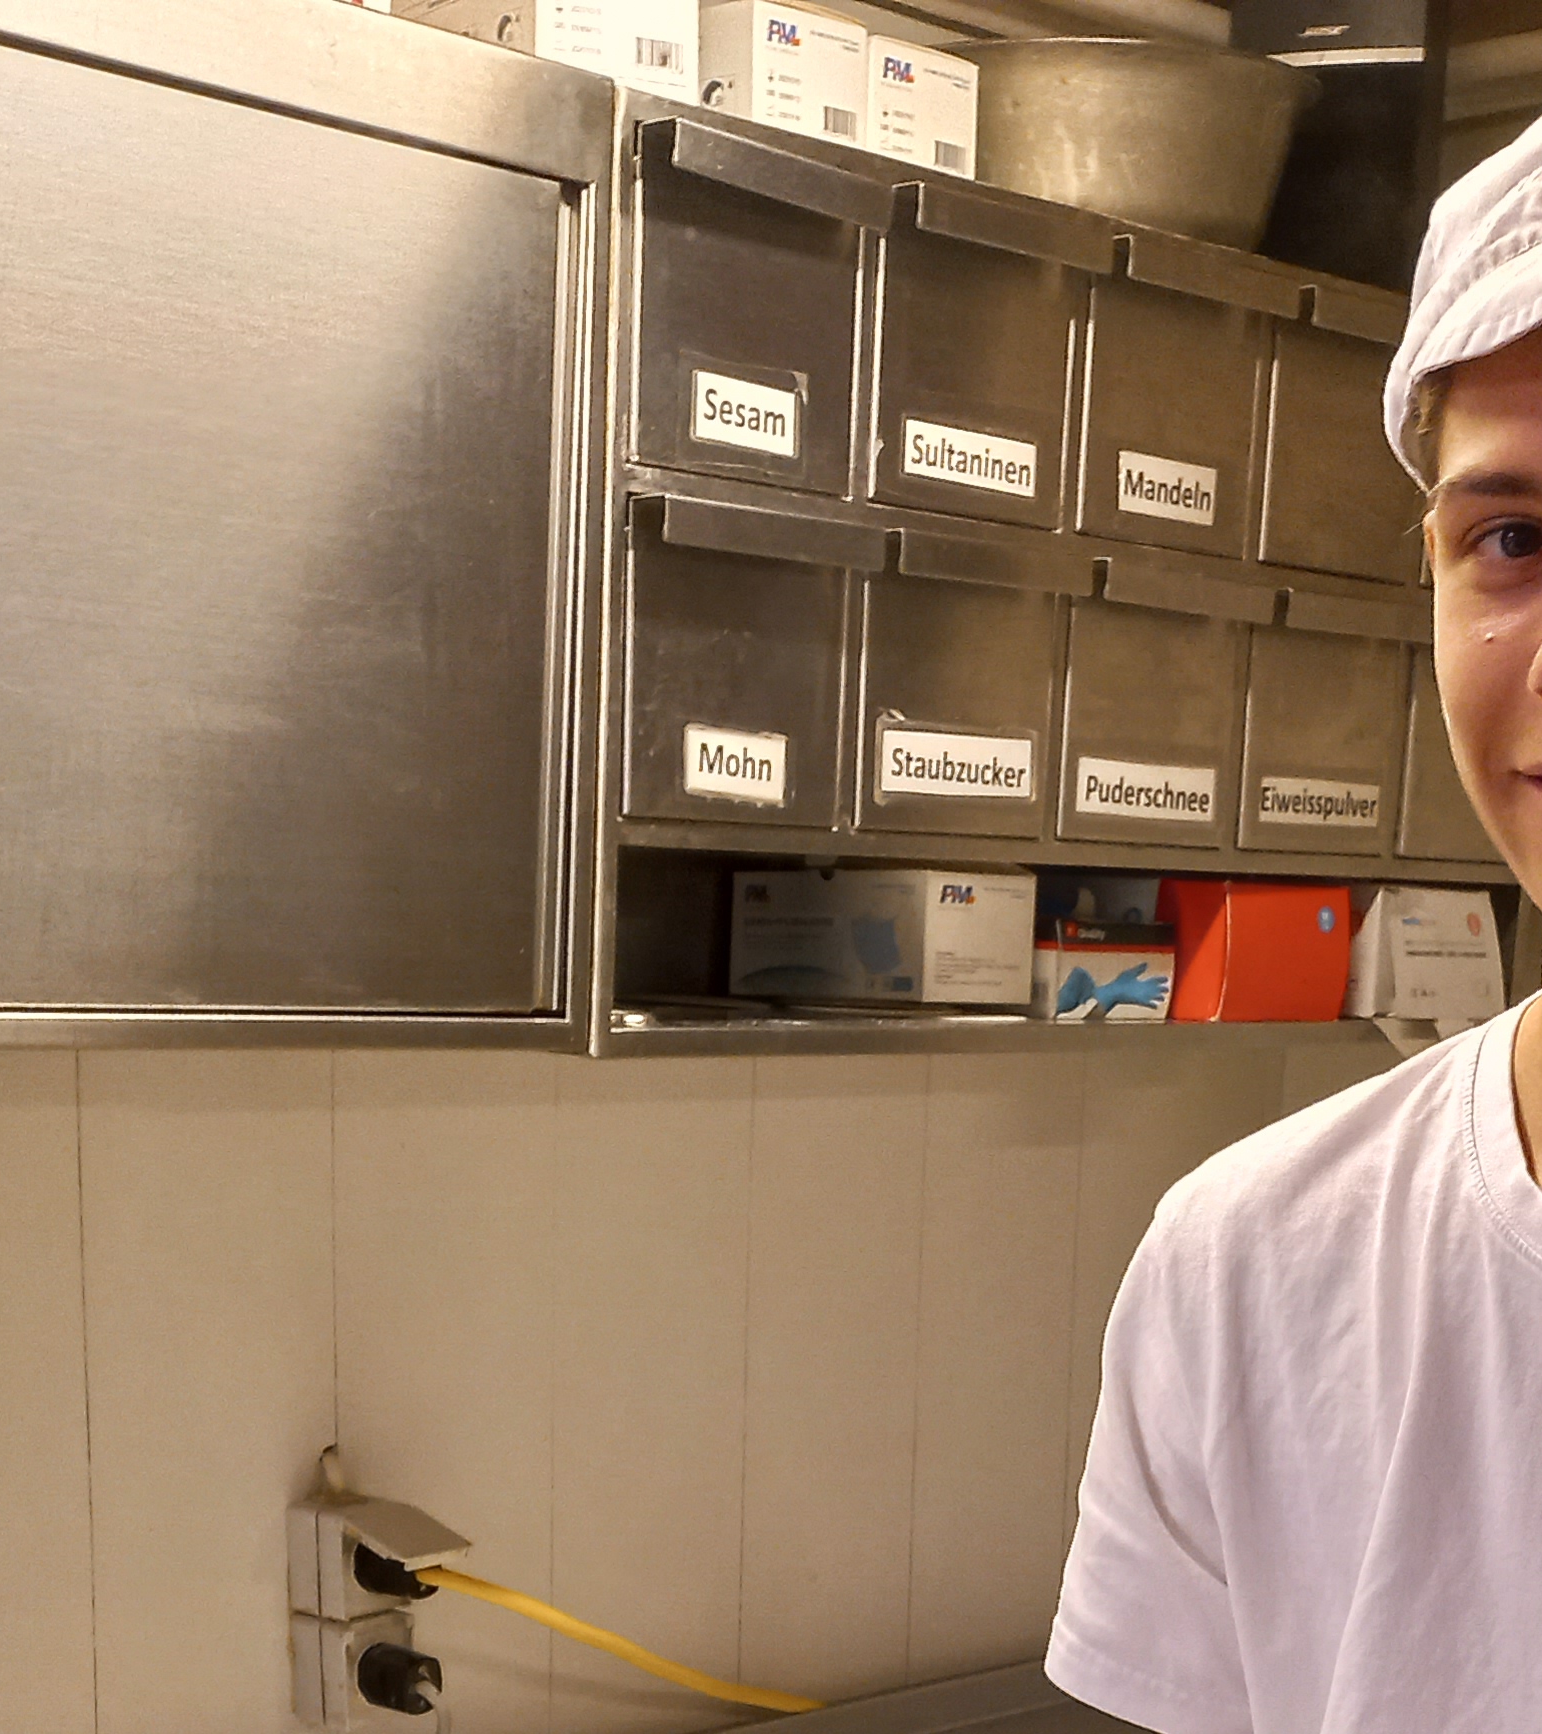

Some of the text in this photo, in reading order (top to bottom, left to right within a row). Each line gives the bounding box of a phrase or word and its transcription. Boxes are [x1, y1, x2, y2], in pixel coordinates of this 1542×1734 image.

[703, 388, 786, 437] Sesam
[911, 434, 1032, 487] Sultaninen
[1123, 469, 1212, 512] Mandeln
[698, 742, 772, 782] Mohn
[891, 747, 1026, 788] Staubzucker
[1085, 775, 1210, 813] Puderschnee
[1261, 786, 1377, 820] Eiweisspulver
